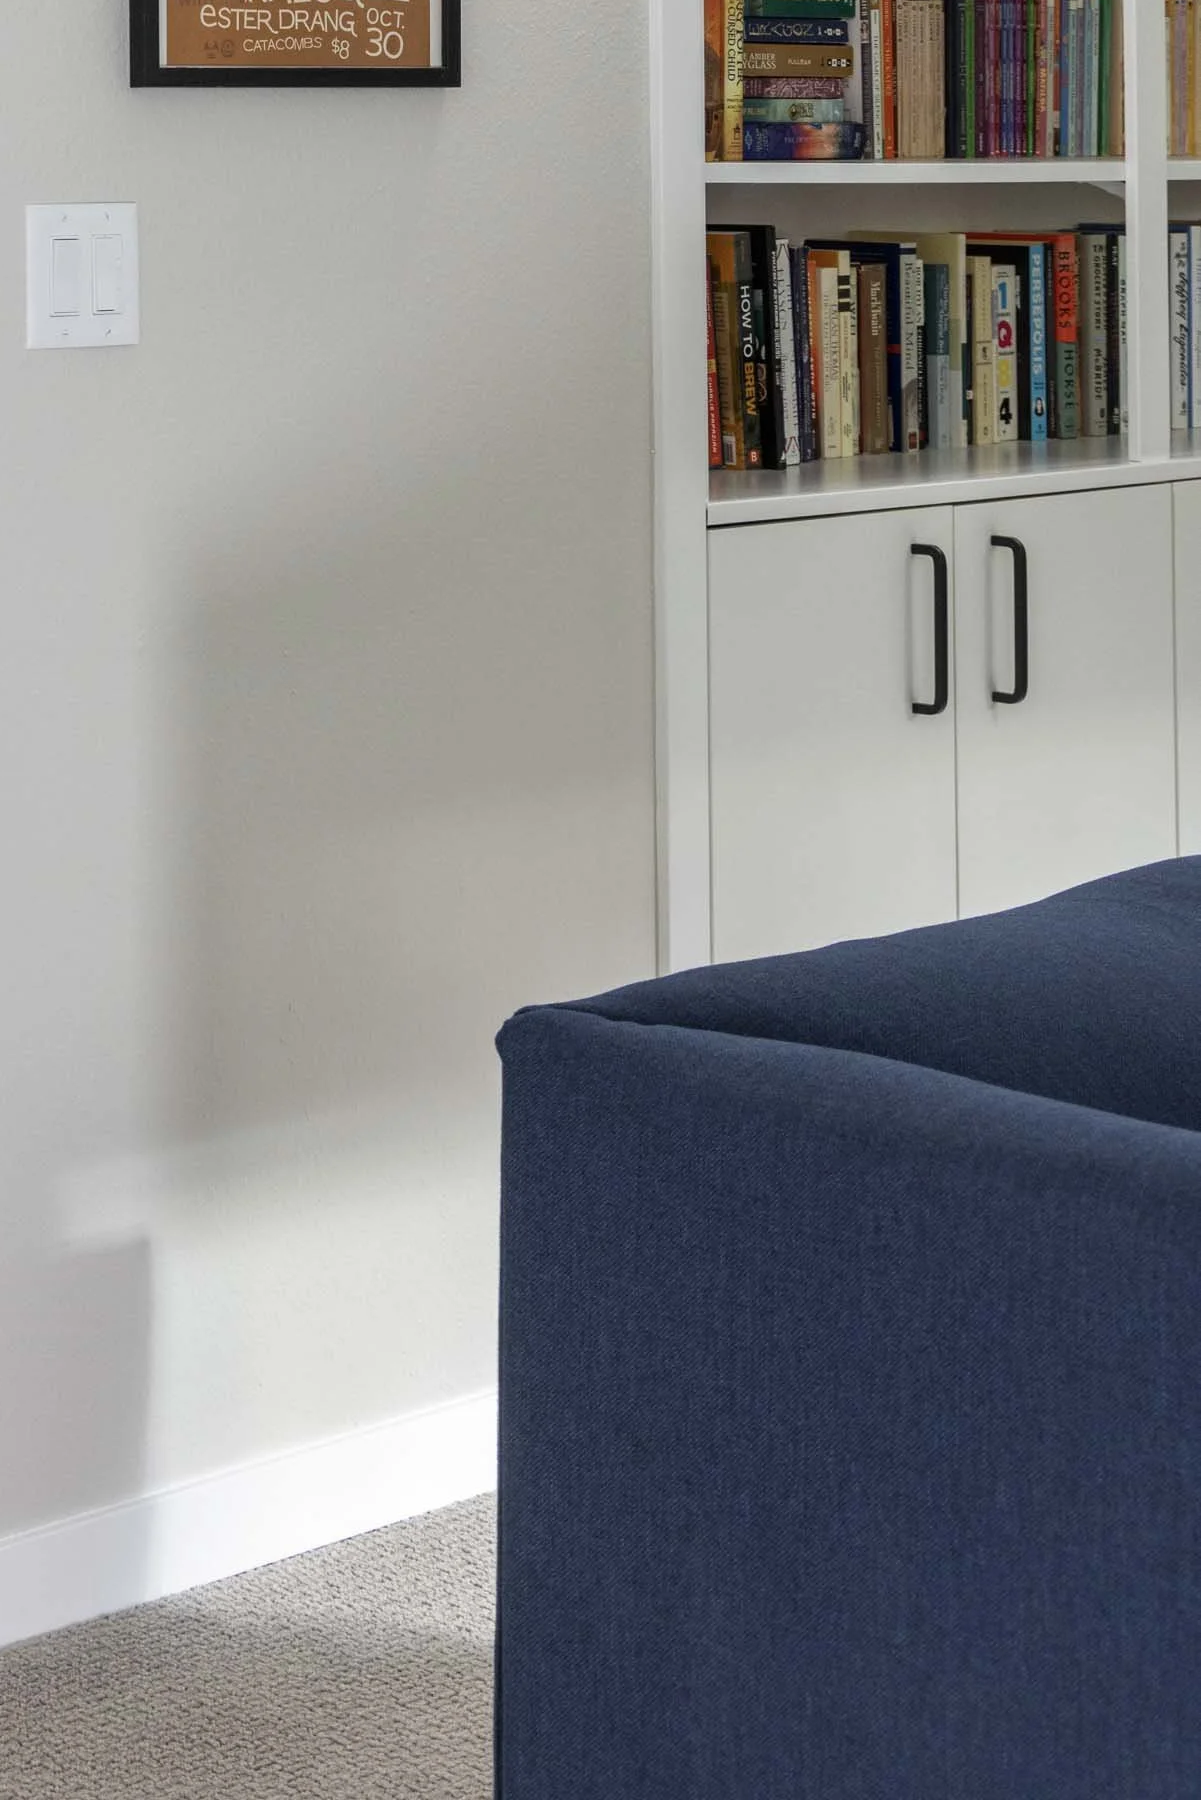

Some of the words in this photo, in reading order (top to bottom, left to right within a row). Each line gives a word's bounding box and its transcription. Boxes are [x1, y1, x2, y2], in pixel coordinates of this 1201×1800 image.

[278, 7, 358, 37] DRANG
[727, 7, 737, 46] CURSED
[748, 21, 818, 38] ERAGON
[242, 36, 323, 54] CATACOMBS
[330, 38, 351, 61] $8
[364, 27, 404, 60] 30
[750, 53, 777, 61] AMBER
[727, 48, 737, 82] CHILD
[742, 60, 777, 70] YGLASS
[740, 285, 753, 328] HOW
[869, 280, 882, 309] Mark
[903, 262, 915, 325] Beautiful
[1057, 251, 1073, 329] BROOKS
[870, 308, 882, 336] Twain
[1032, 253, 1045, 375] PERSEPOLIS
[743, 332, 754, 358] TO
[904, 332, 916, 371] Mind
[743, 361, 758, 416] BREW
[1062, 349, 1075, 410] HORSE
